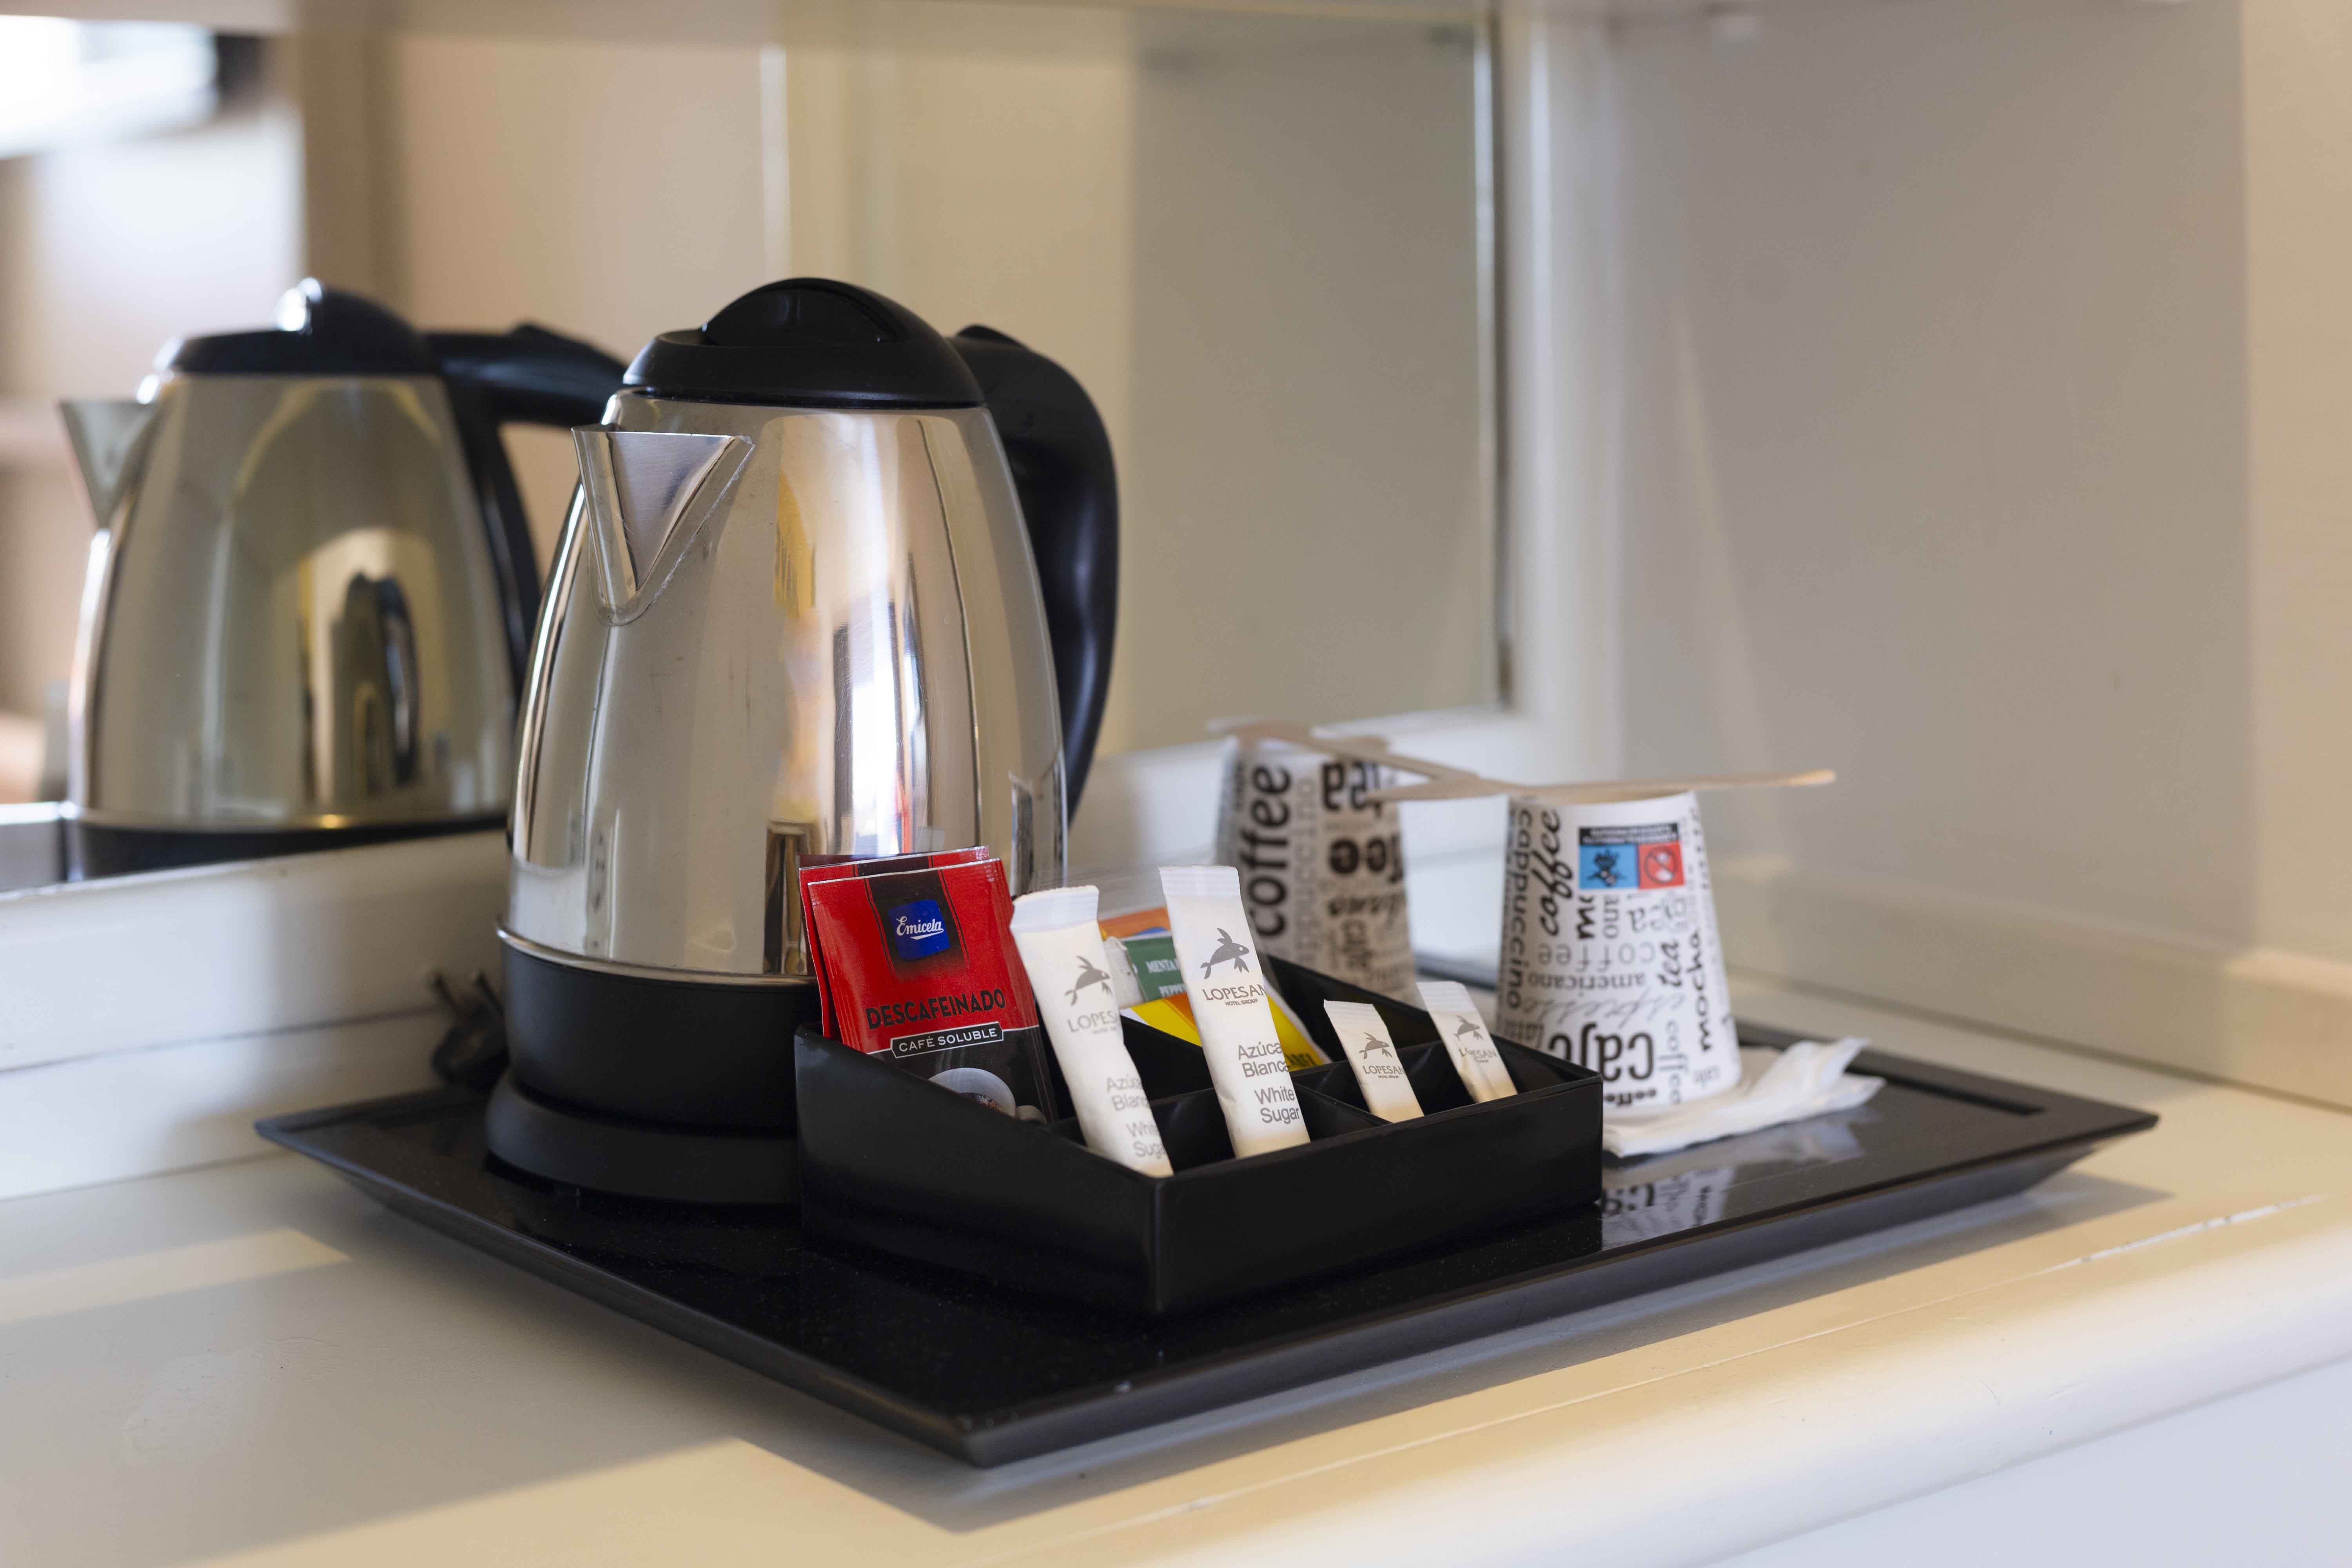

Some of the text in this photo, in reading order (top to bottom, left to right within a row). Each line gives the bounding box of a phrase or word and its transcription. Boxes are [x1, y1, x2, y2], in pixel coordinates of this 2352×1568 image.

[1239, 766, 1291, 937] coffee
[1532, 809, 1572, 936] coffee
[1506, 808, 1533, 1009] cappuccino
[896, 916, 944, 938] Emicela
[1538, 943, 1655, 972] coffee
[1202, 984, 1267, 1000] LOPESAN
[1528, 972, 1645, 996] americano
[1688, 930, 1711, 1052] mocha
[865, 988, 1005, 1030] DESCAFEINADO
[899, 1028, 996, 1053] CAFÉ SOLUBLE
[1238, 1042, 1282, 1060] Azúca
[1362, 1065, 1405, 1074] LOPESAN
[1254, 1085, 1295, 1105] White
[1260, 1107, 1300, 1124] Sugar
